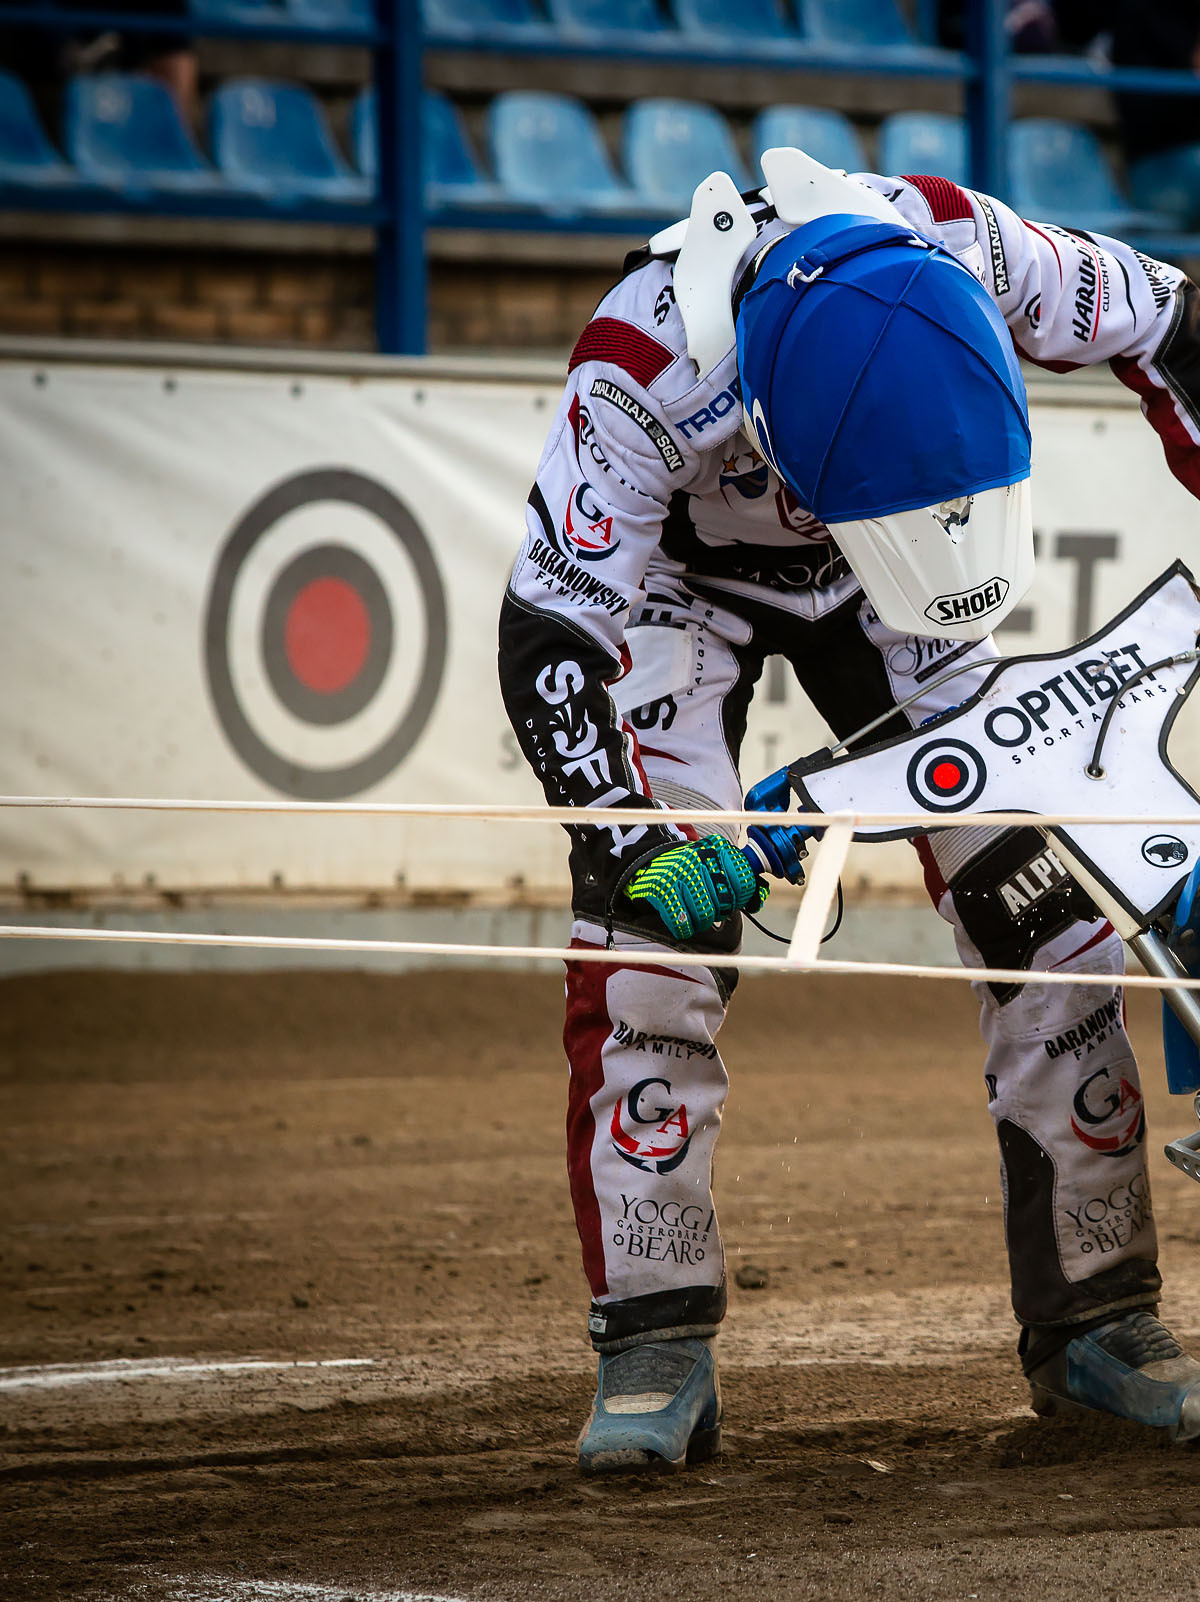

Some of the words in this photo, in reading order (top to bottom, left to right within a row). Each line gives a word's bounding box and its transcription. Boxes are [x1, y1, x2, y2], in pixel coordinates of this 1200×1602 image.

[1102, 269, 1110, 312] CLUTCH
[591, 380, 653, 429] MALINIAK
[528, 538, 629, 617] BARANOWSKY
[937, 582, 1002, 621] SHOEI
[984, 643, 1157, 748] OPTIBET
[1012, 711, 1102, 765] SPORTA
[1117, 684, 1167, 709] BĀRS
[628, 1077, 689, 1139] GA
[1074, 1067, 1141, 1125] GA
[620, 1193, 715, 1233] YOGGI
[626, 1232, 697, 1266] BEAR
